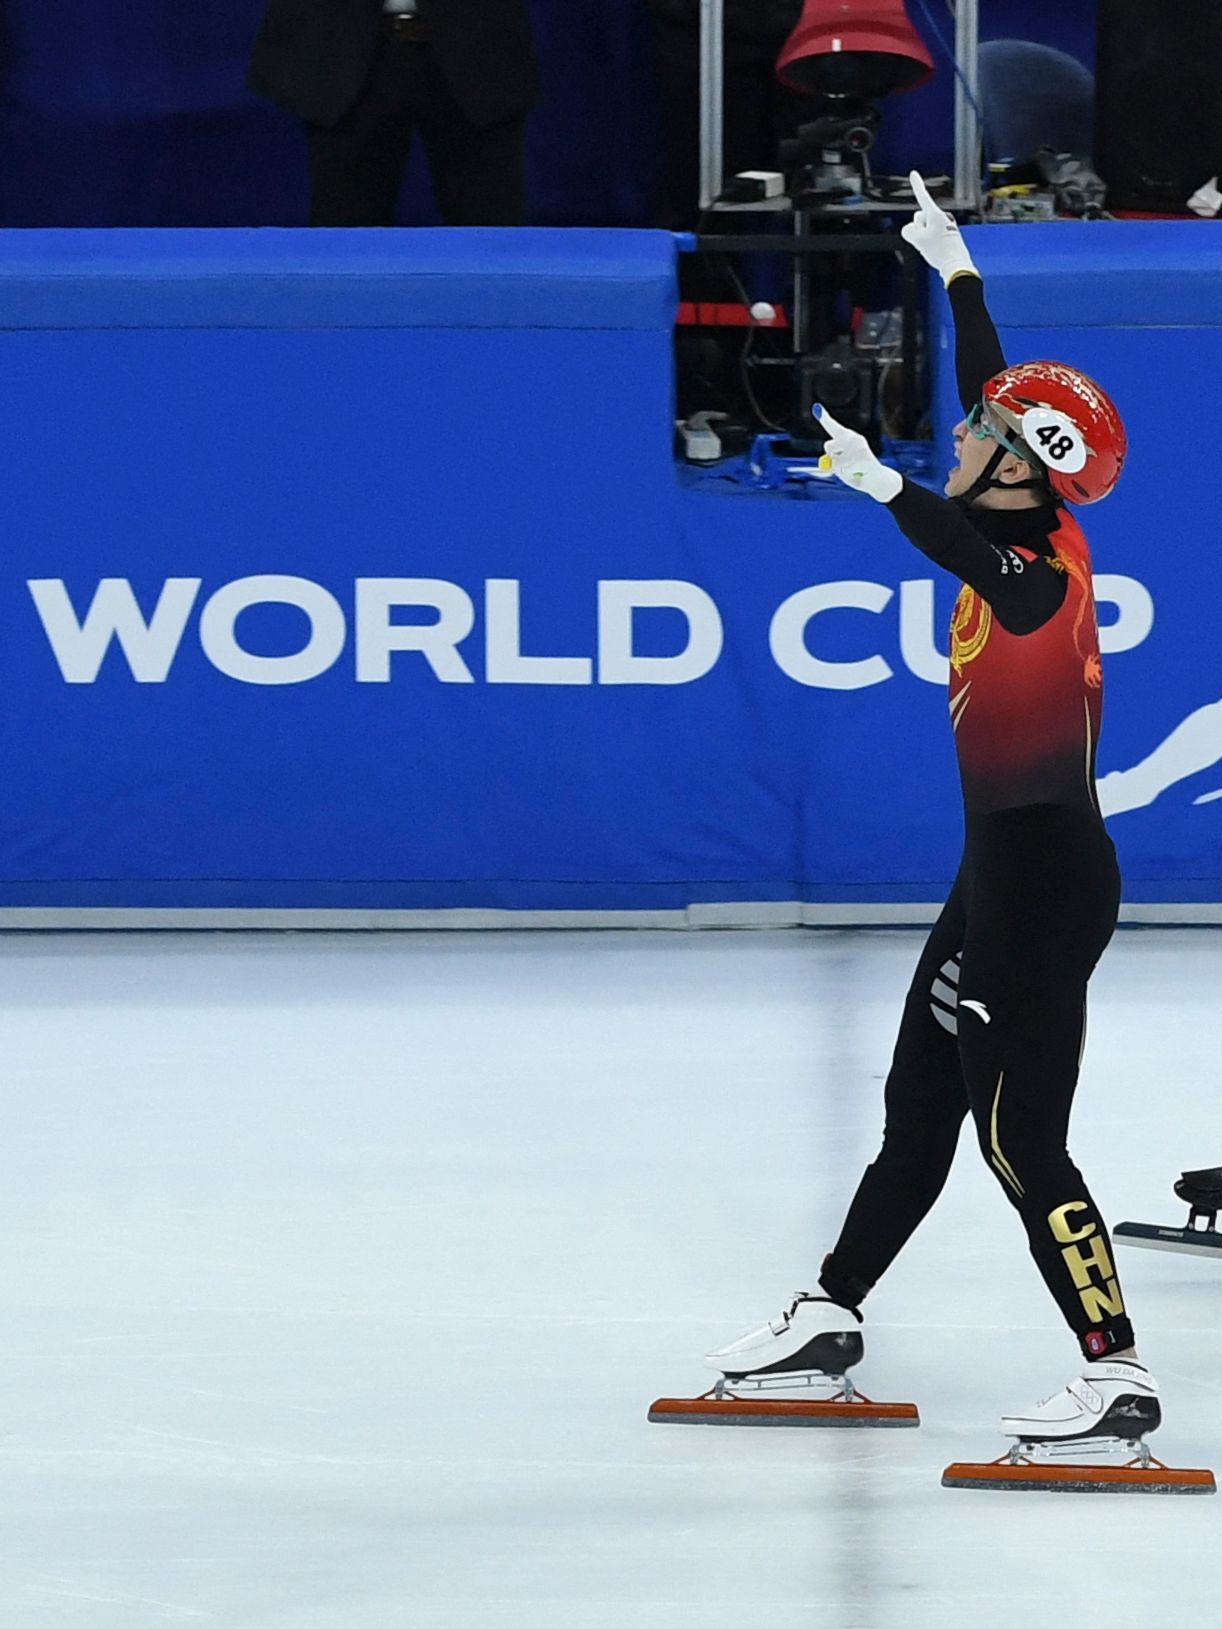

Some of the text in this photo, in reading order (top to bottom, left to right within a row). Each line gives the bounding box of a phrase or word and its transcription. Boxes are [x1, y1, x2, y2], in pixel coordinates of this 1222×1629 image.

[1035, 425, 1074, 460] 48
[26, 574, 724, 685] WORLD
[1047, 1200, 1124, 1323] CHN
